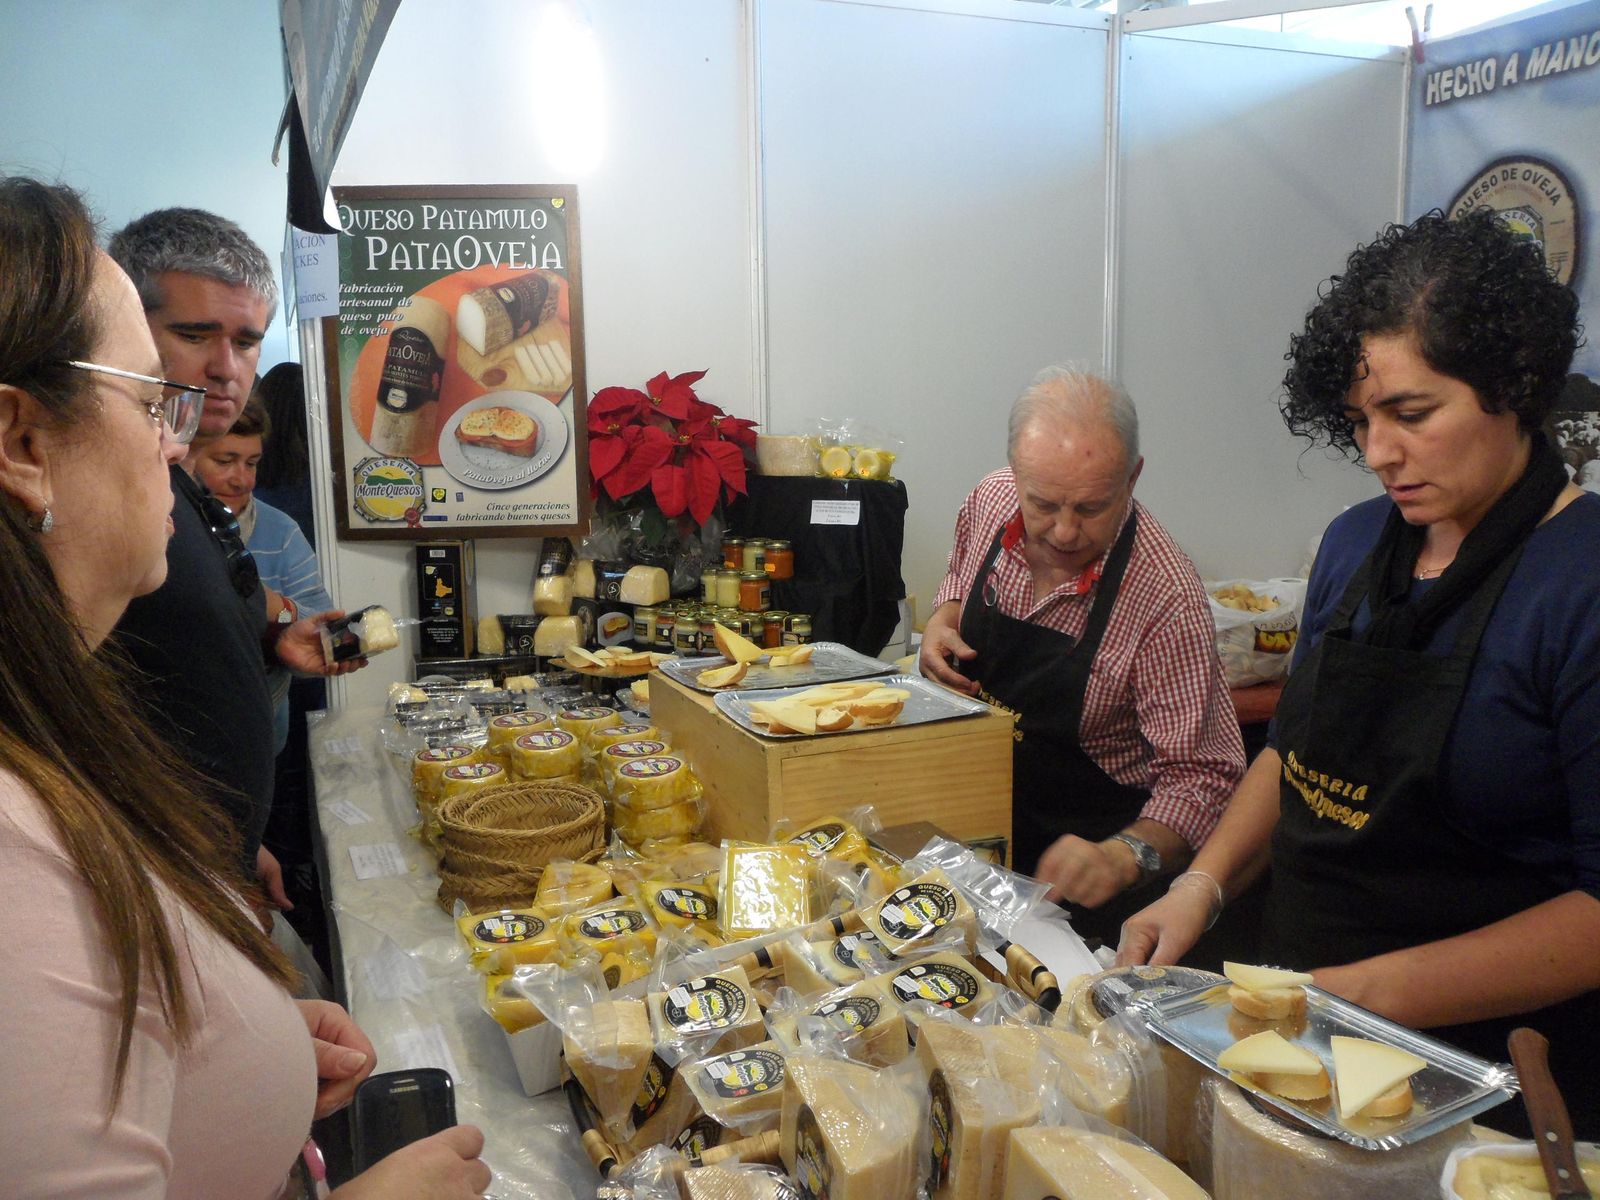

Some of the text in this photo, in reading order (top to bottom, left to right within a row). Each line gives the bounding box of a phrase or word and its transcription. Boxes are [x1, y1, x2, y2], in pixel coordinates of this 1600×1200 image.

[1426, 57, 1497, 105] HECHO
[1502, 52, 1519, 87] A
[1456, 174, 1498, 219] QUESO
[1501, 167, 1518, 181] DE
[1522, 169, 1562, 207] OVEJA
[339, 204, 547, 236] QUESO PATAMULO
[339, 282, 404, 293] Fabricación
[339, 297, 412, 307] artesanal de
[340, 313, 404, 323] queso puro
[340, 325, 354, 335] de
[360, 325, 388, 336] oveja
[515, 469, 525, 481] al
[356, 484, 421, 499] MonteQuesos
[486, 501, 570, 513] Cinco generaciones
[456, 512, 505, 522] fabricando
[507, 512, 538, 521] buenos
[540, 513, 571, 522] quesos
